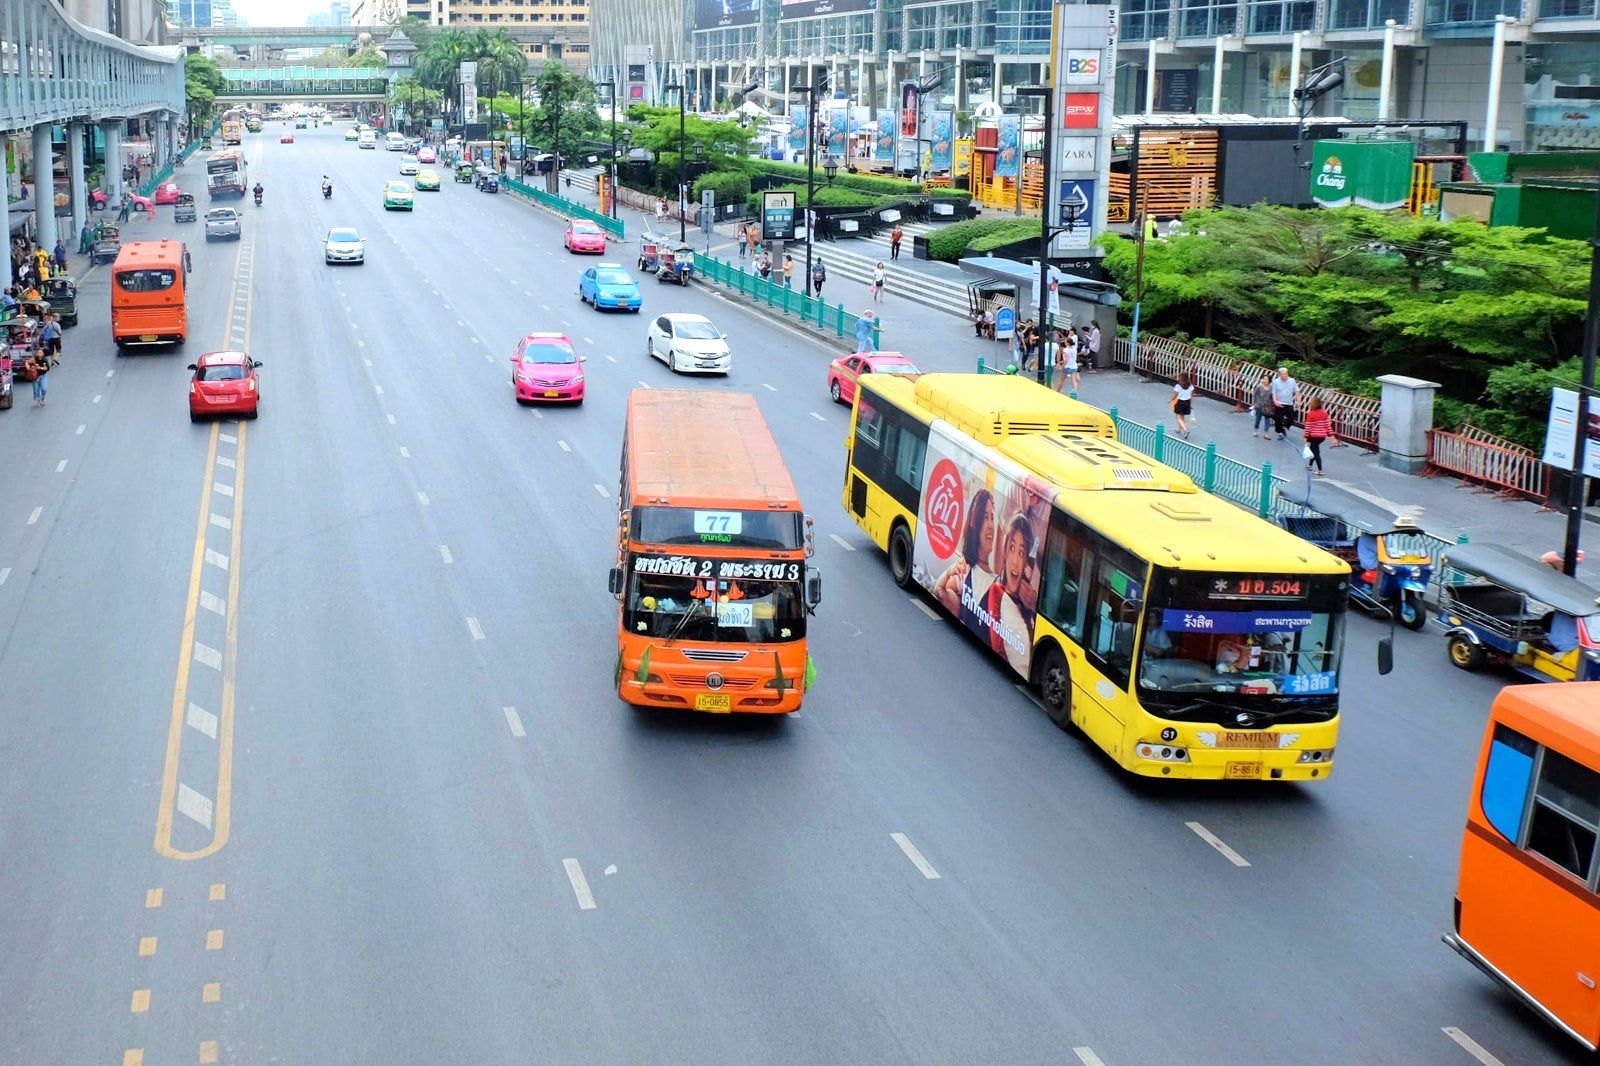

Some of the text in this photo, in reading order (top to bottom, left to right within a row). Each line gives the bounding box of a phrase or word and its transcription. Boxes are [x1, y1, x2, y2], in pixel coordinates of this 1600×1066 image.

[1069, 58, 1098, 73] B2S
[1065, 150, 1093, 158] ZARA
[1317, 173, 1346, 190] Chang
[706, 515, 731, 531] 77
[634, 556, 799, 580] หมอชิต 2 พระราม 3
[1183, 613, 1214, 629] รังสิต
[1162, 730, 1175, 739] 51
[1219, 731, 1278, 742] REMIUM
